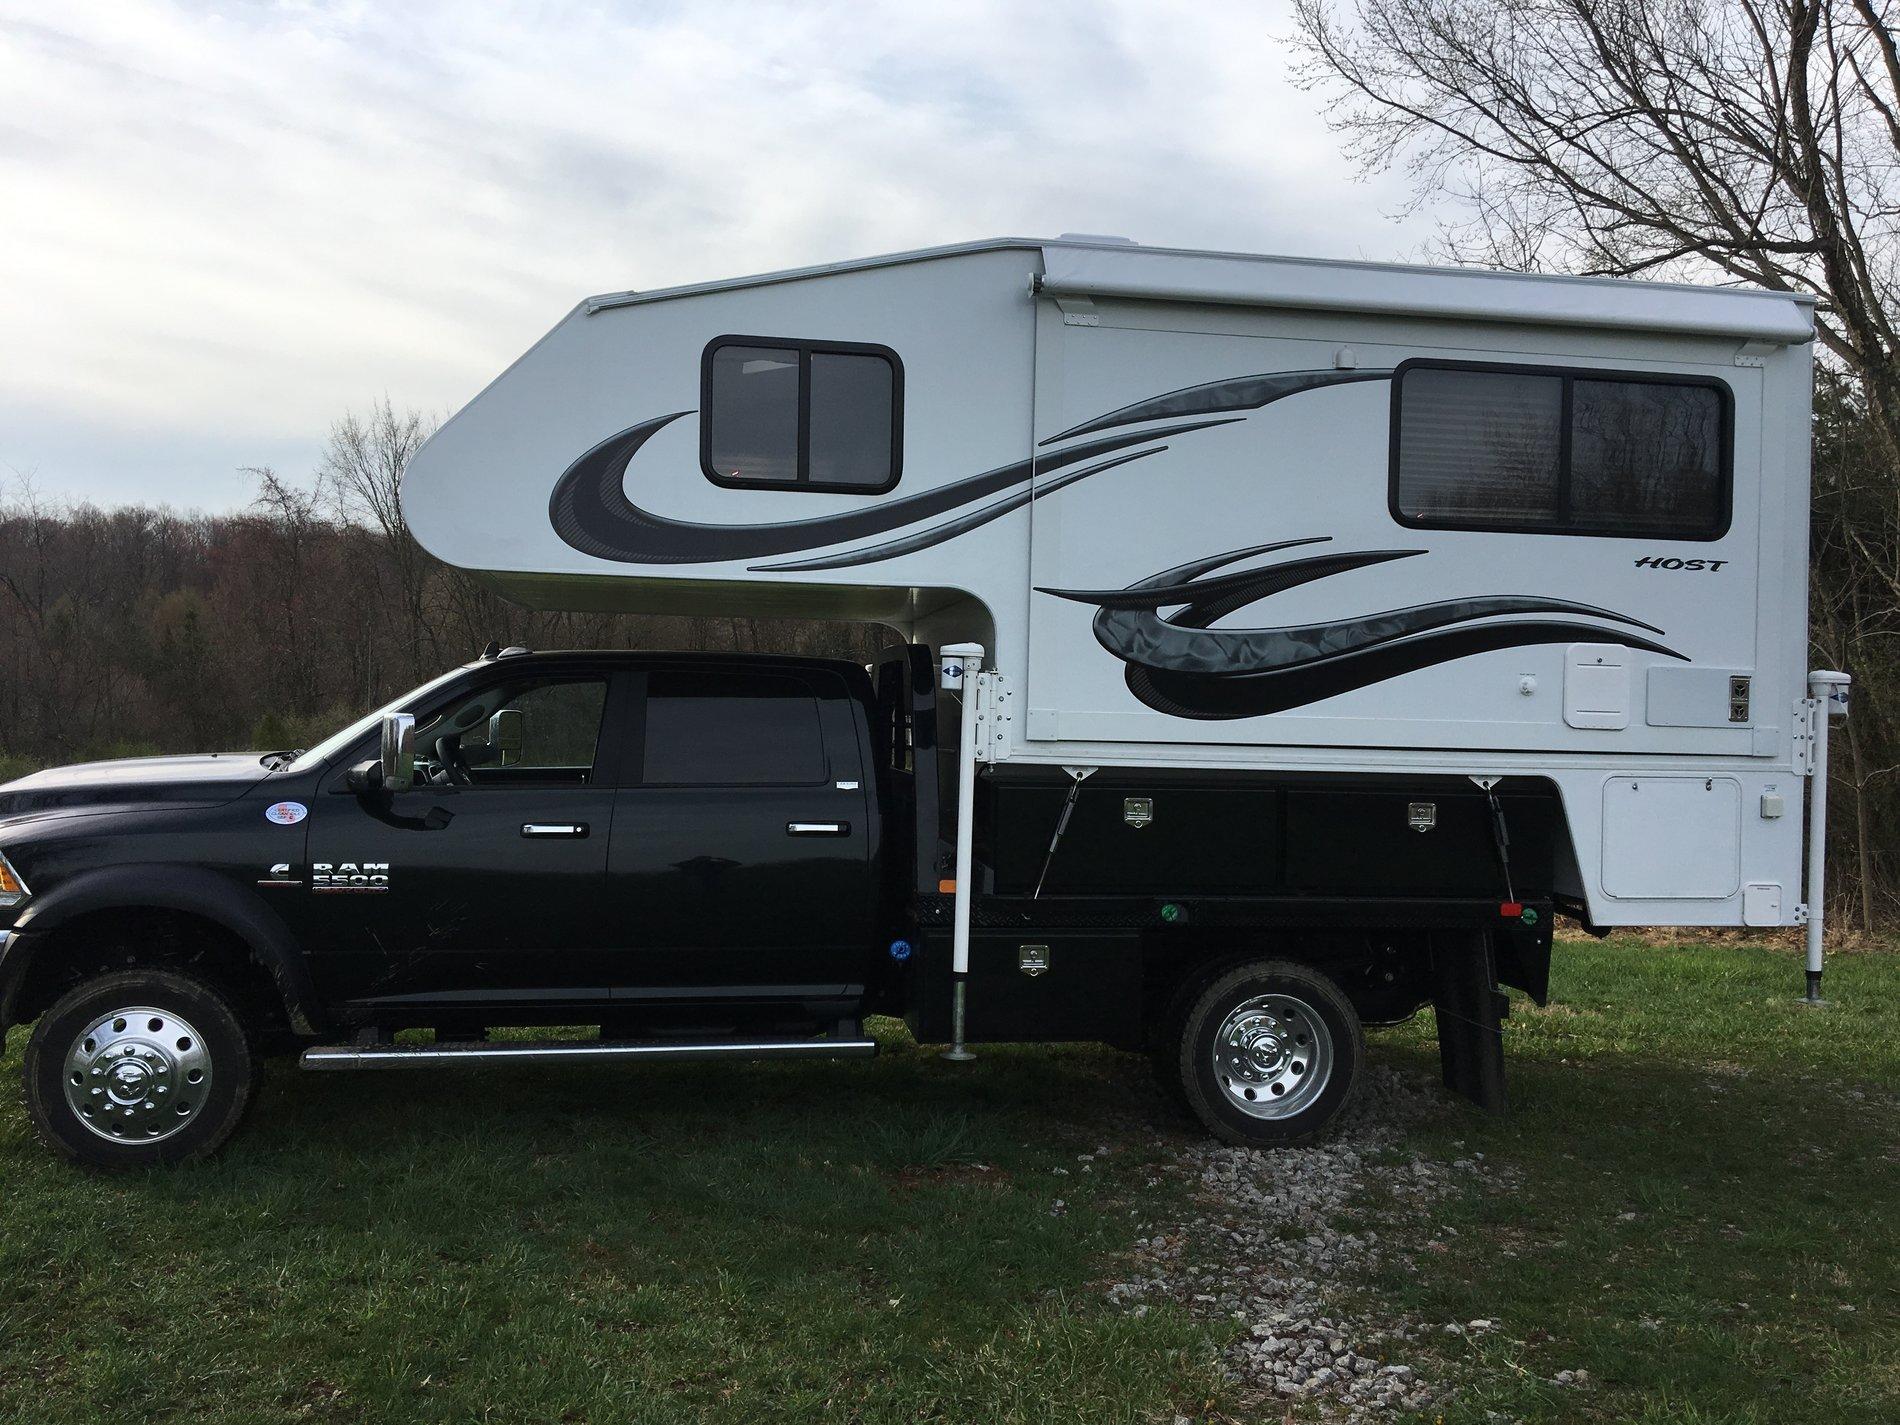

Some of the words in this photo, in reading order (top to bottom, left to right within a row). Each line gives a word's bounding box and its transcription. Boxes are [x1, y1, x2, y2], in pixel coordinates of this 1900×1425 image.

[1634, 556, 1729, 572] HOST
[313, 863, 390, 875] RAM
[313, 875, 389, 886] 5500
